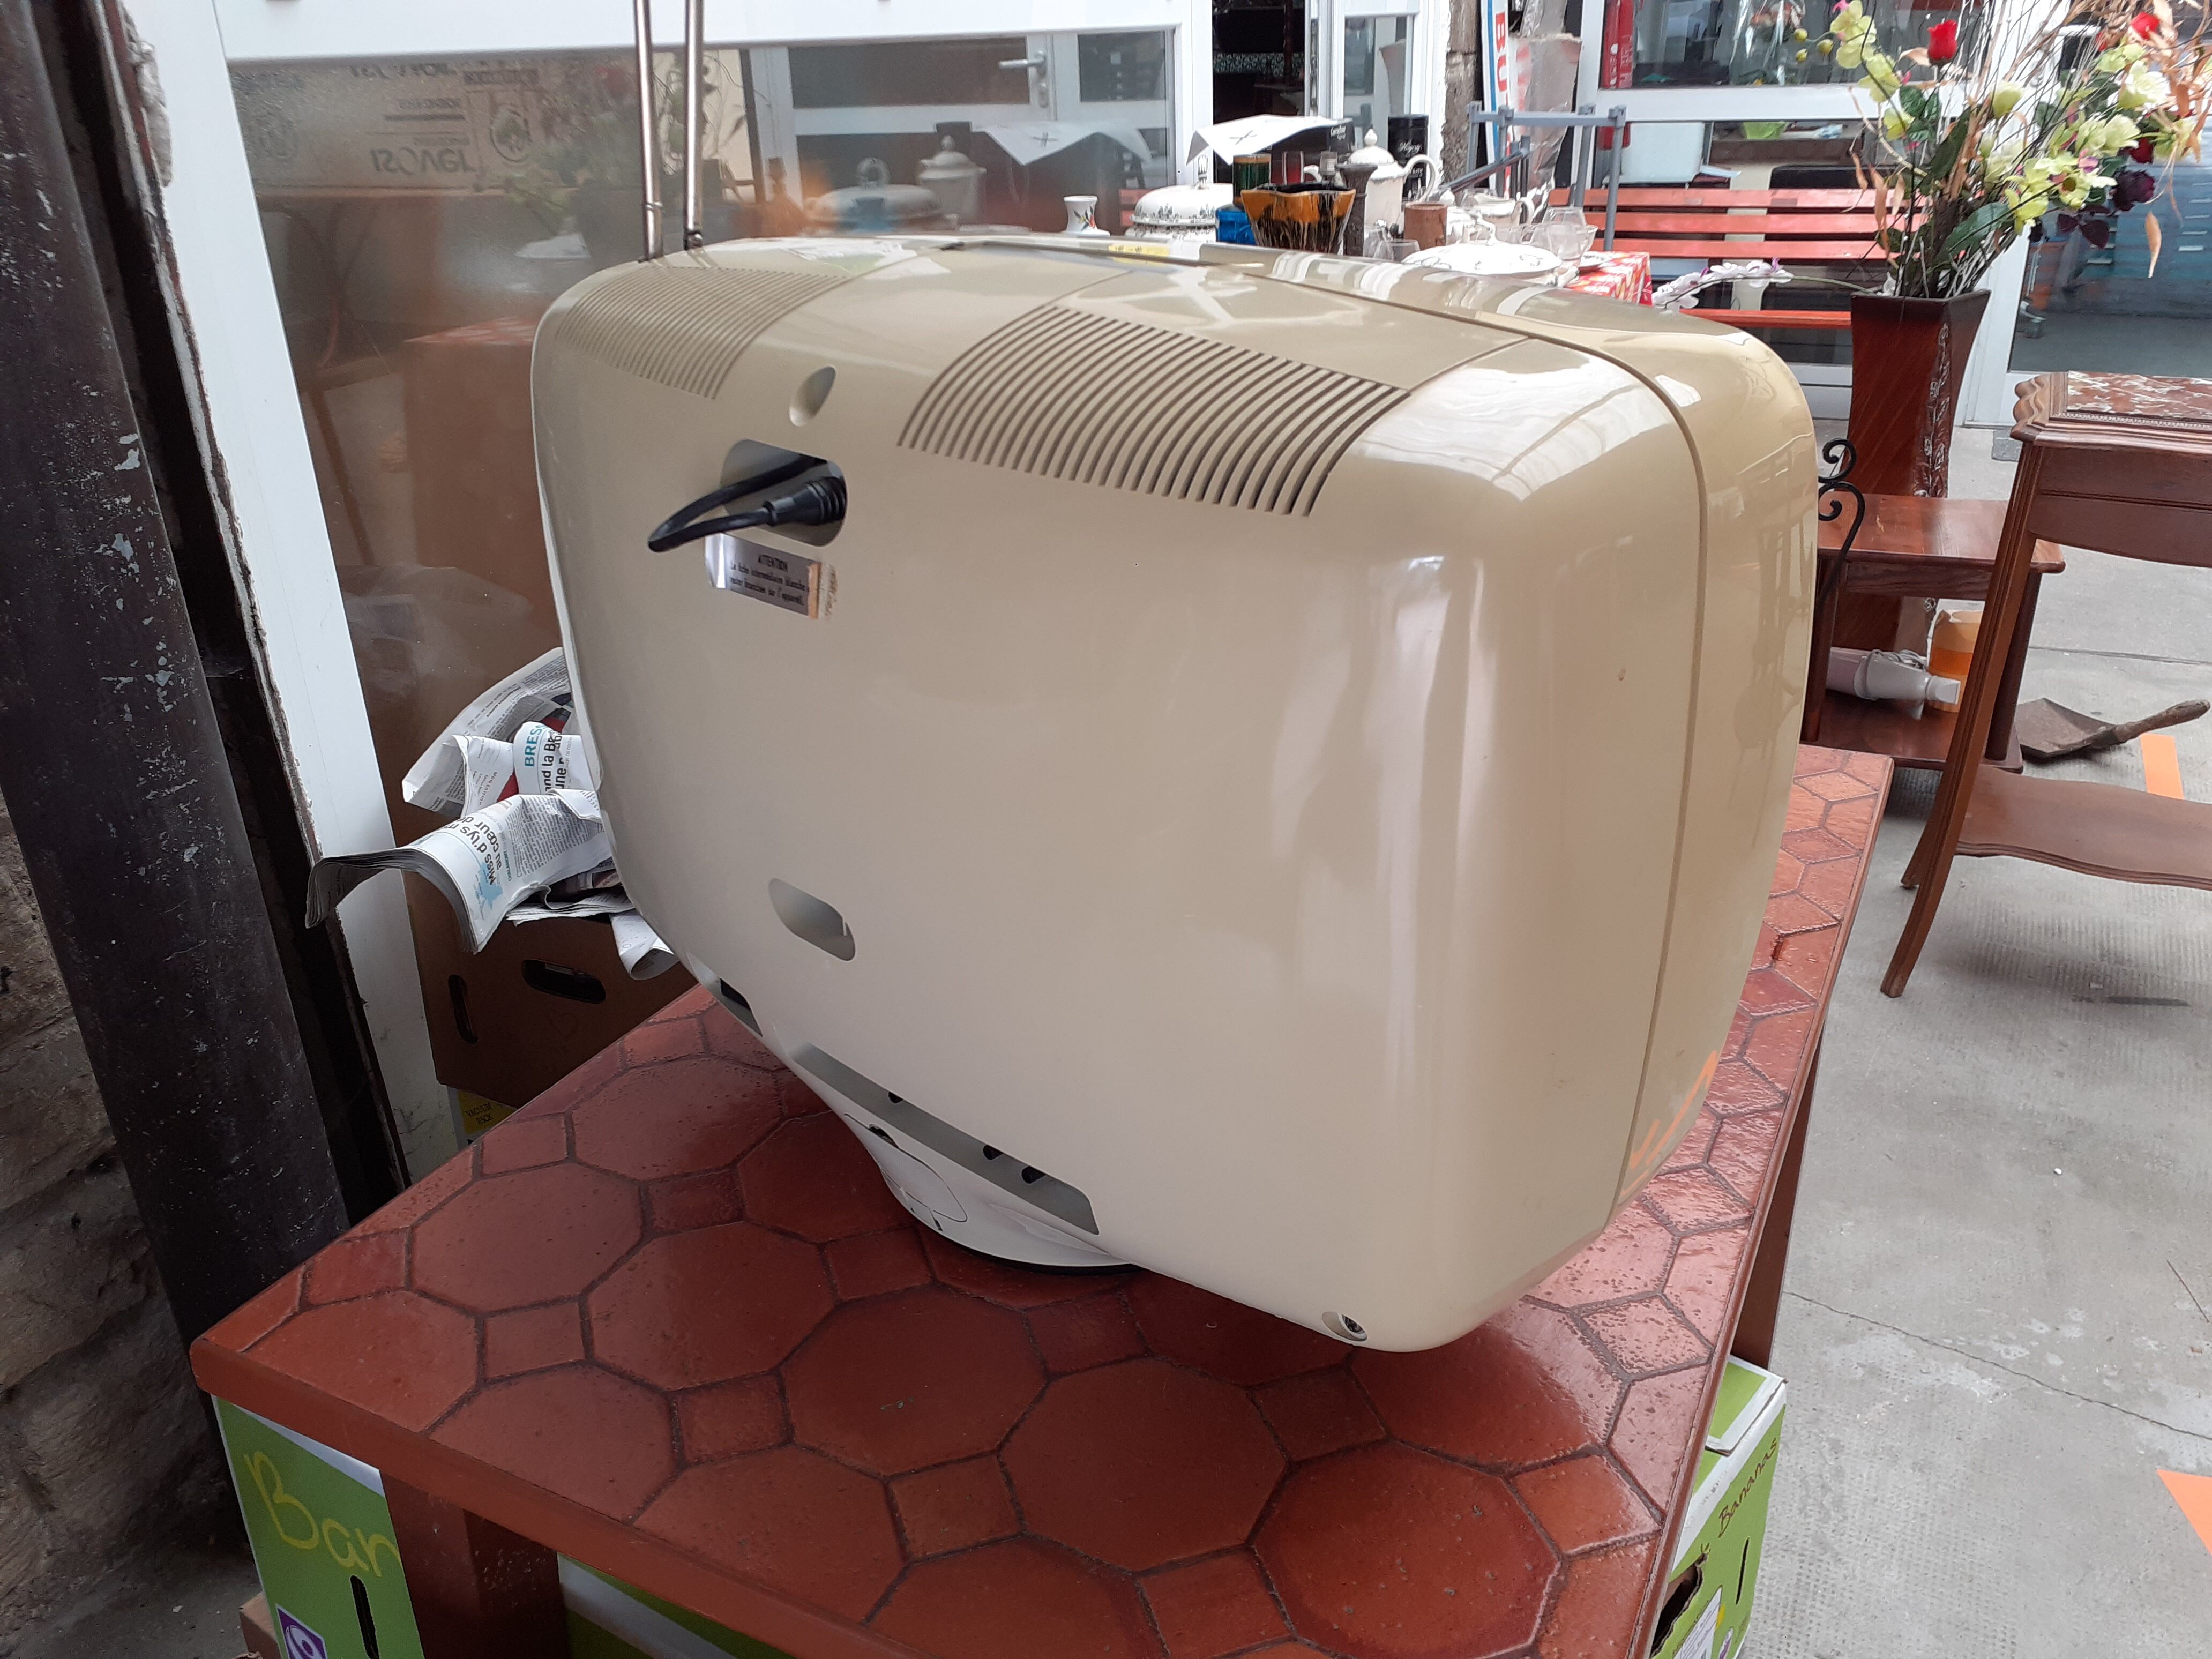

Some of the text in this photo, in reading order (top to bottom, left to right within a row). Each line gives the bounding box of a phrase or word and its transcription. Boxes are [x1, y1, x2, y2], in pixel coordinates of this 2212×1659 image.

[541, 755, 554, 767] la
[489, 772, 497, 783] MON
[541, 770, 551, 792] and
[474, 821, 499, 853] cœur
[484, 853, 496, 885] Miss
[495, 853, 502, 870] au
[465, 1102, 493, 1117] VACUUM
[476, 1114, 494, 1125] PACK
[1718, 1438, 1777, 1538] Bananas
